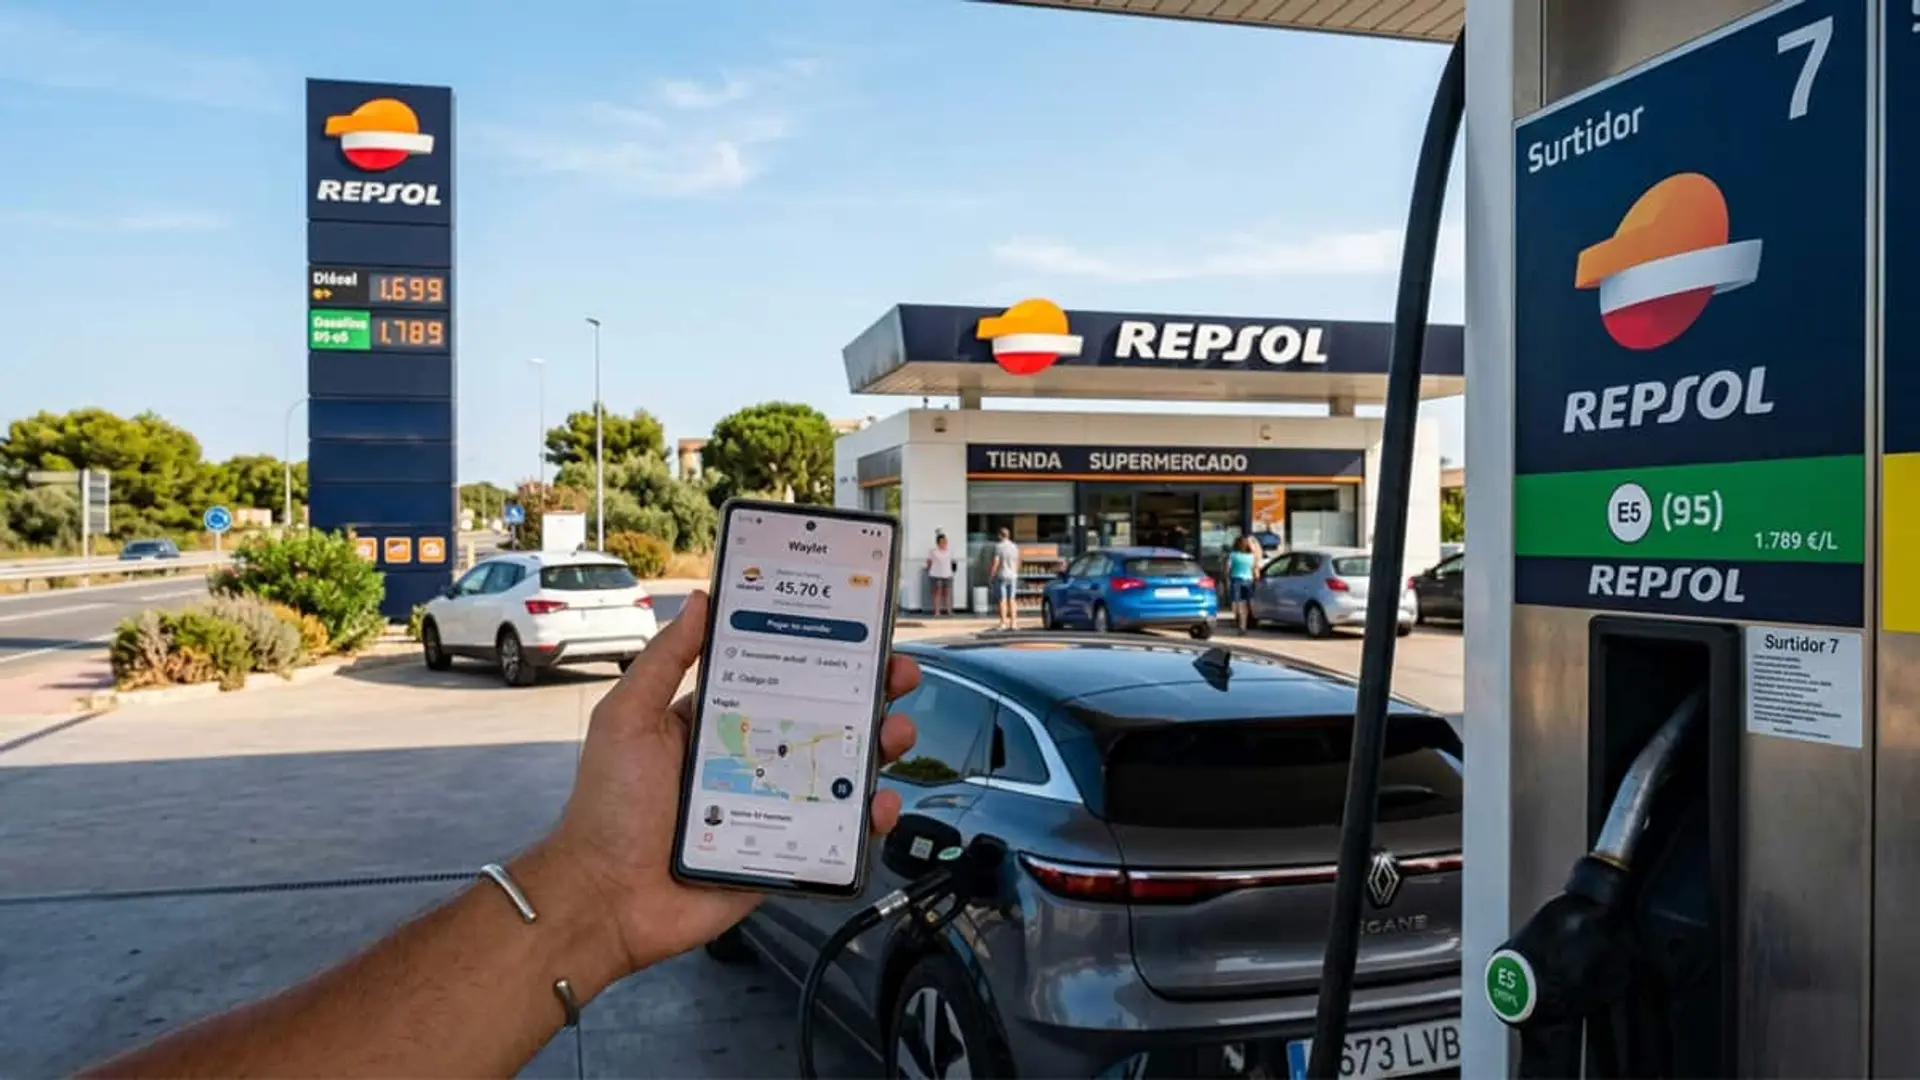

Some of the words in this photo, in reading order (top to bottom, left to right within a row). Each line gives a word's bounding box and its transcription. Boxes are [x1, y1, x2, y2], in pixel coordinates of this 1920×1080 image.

[1528, 105, 1644, 173] Surtidor
[1777, 15, 1834, 120] 7
[317, 179, 441, 205] REPSOL
[380, 276, 443, 302] 1.699
[380, 320, 443, 344] 1.789
[1115, 320, 1329, 365] REPSOL
[1562, 366, 1774, 434] REPSOL
[986, 451, 1063, 470] TIENDA
[1089, 452, 1248, 472] SUPERMERCADO
[1617, 501, 1641, 524] E5
[1662, 490, 1724, 532] (95)
[788, 540, 828, 555] Waylet
[1754, 532, 1801, 550] 1.789
[1807, 531, 1838, 551] €/L
[775, 581, 818, 597] 45.70
[822, 585, 832, 598] €
[1588, 564, 1745, 602] REPSOL
[1764, 633, 1826, 653] Surtidor
[1830, 638, 1841, 654] 7
[1403, 1026, 1461, 1067] LVB
